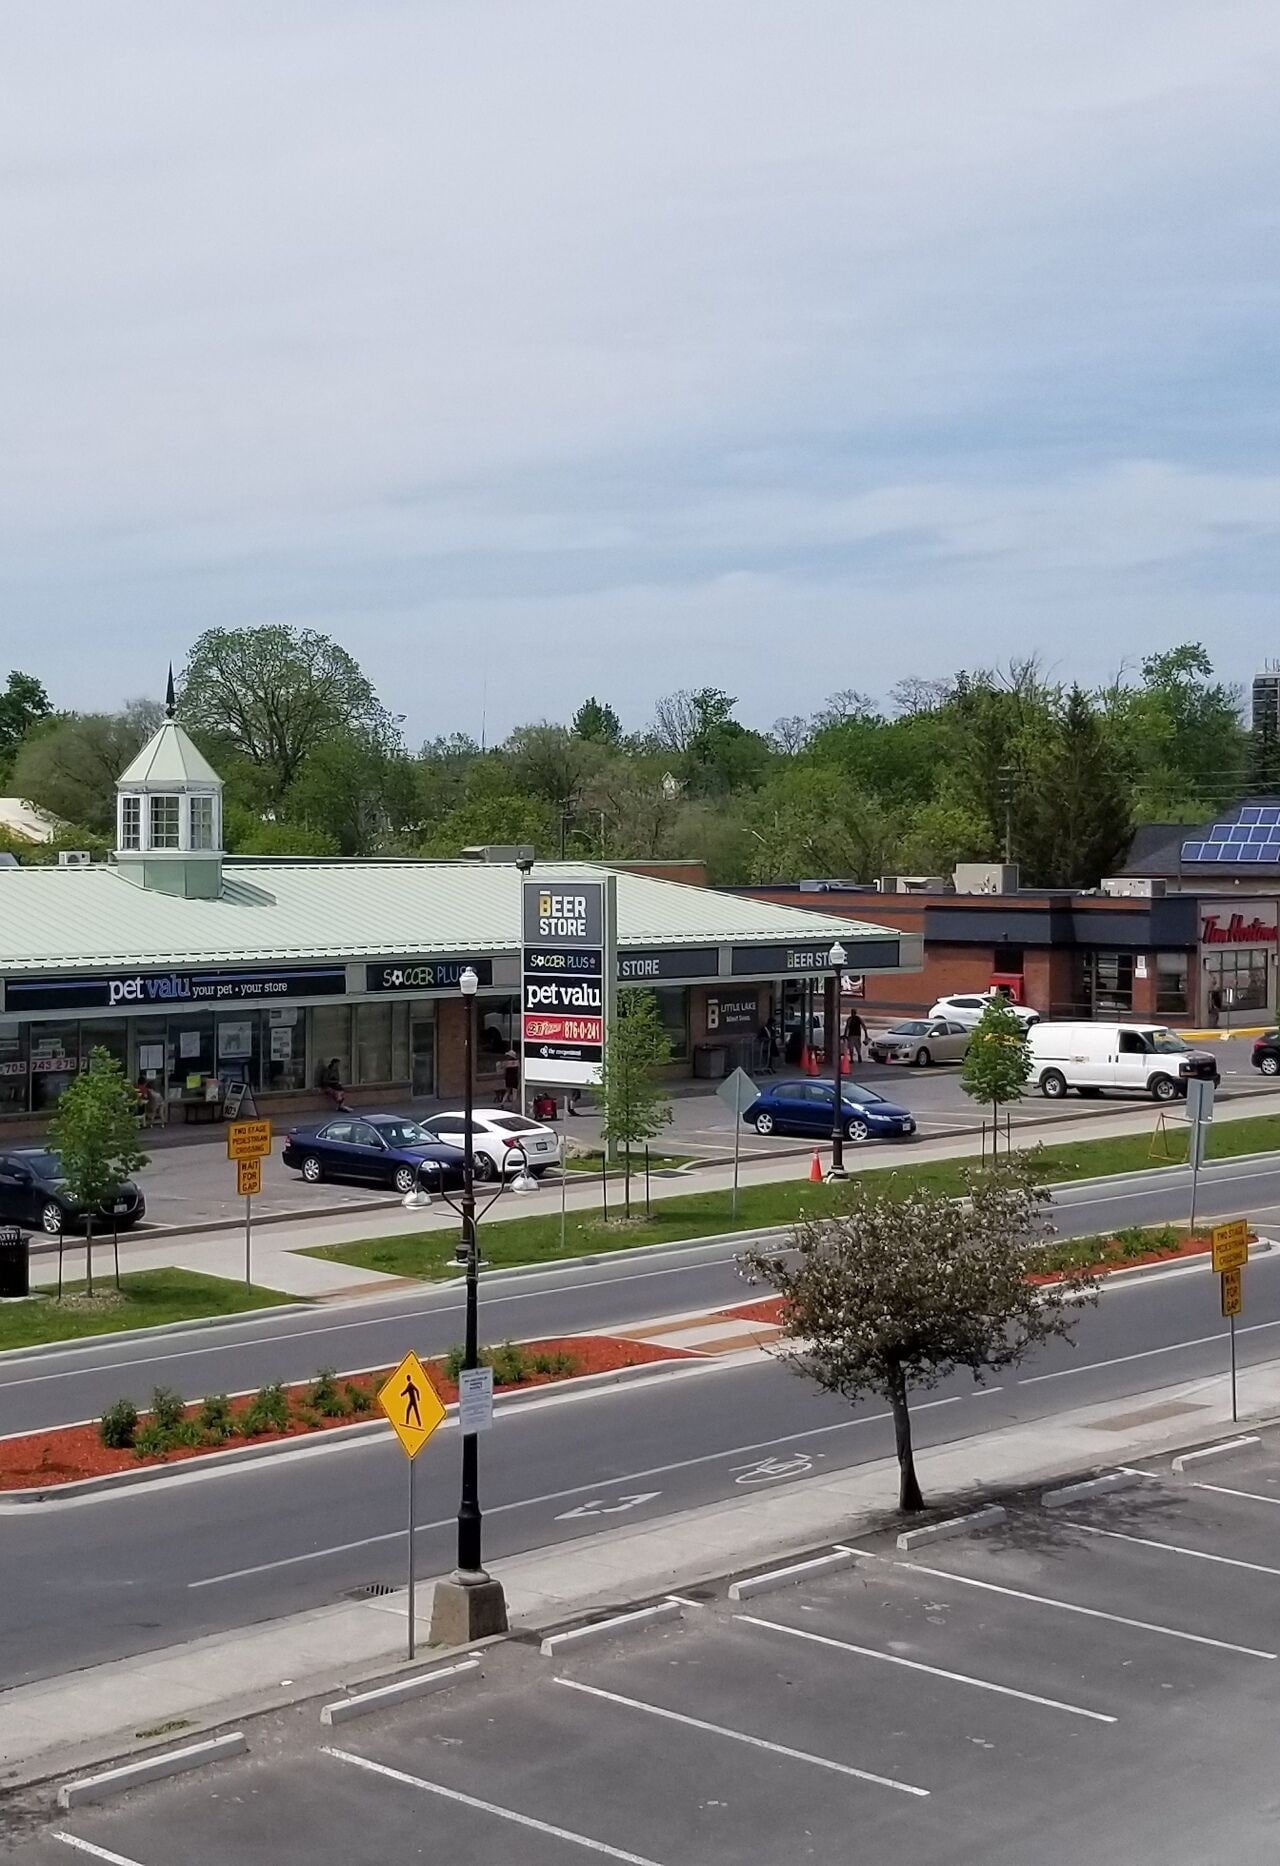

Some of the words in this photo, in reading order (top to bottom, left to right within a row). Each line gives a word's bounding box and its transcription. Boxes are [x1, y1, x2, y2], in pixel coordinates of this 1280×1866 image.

[539, 895, 587, 918] BEER
[539, 918, 587, 937] STORE
[567, 956, 590, 969] PLUS
[786, 951, 814, 968] BEER
[622, 959, 660, 976] STORE
[109, 976, 144, 1006] pet
[145, 974, 191, 999] valu
[192, 986, 215, 999] your
[216, 984, 233, 999] pet
[240, 984, 262, 997] your
[264, 981, 288, 993] store
[526, 983, 559, 1008] pet
[559, 983, 602, 1007] valu
[4, 1063, 26, 1074] 705
[234, 1127, 247, 1136] TWO
[247, 1124, 267, 1134] STAGE
[241, 1160, 259, 1171] WAIT
[242, 1171, 257, 1182] FOR
[242, 1181, 258, 1192] GAP
